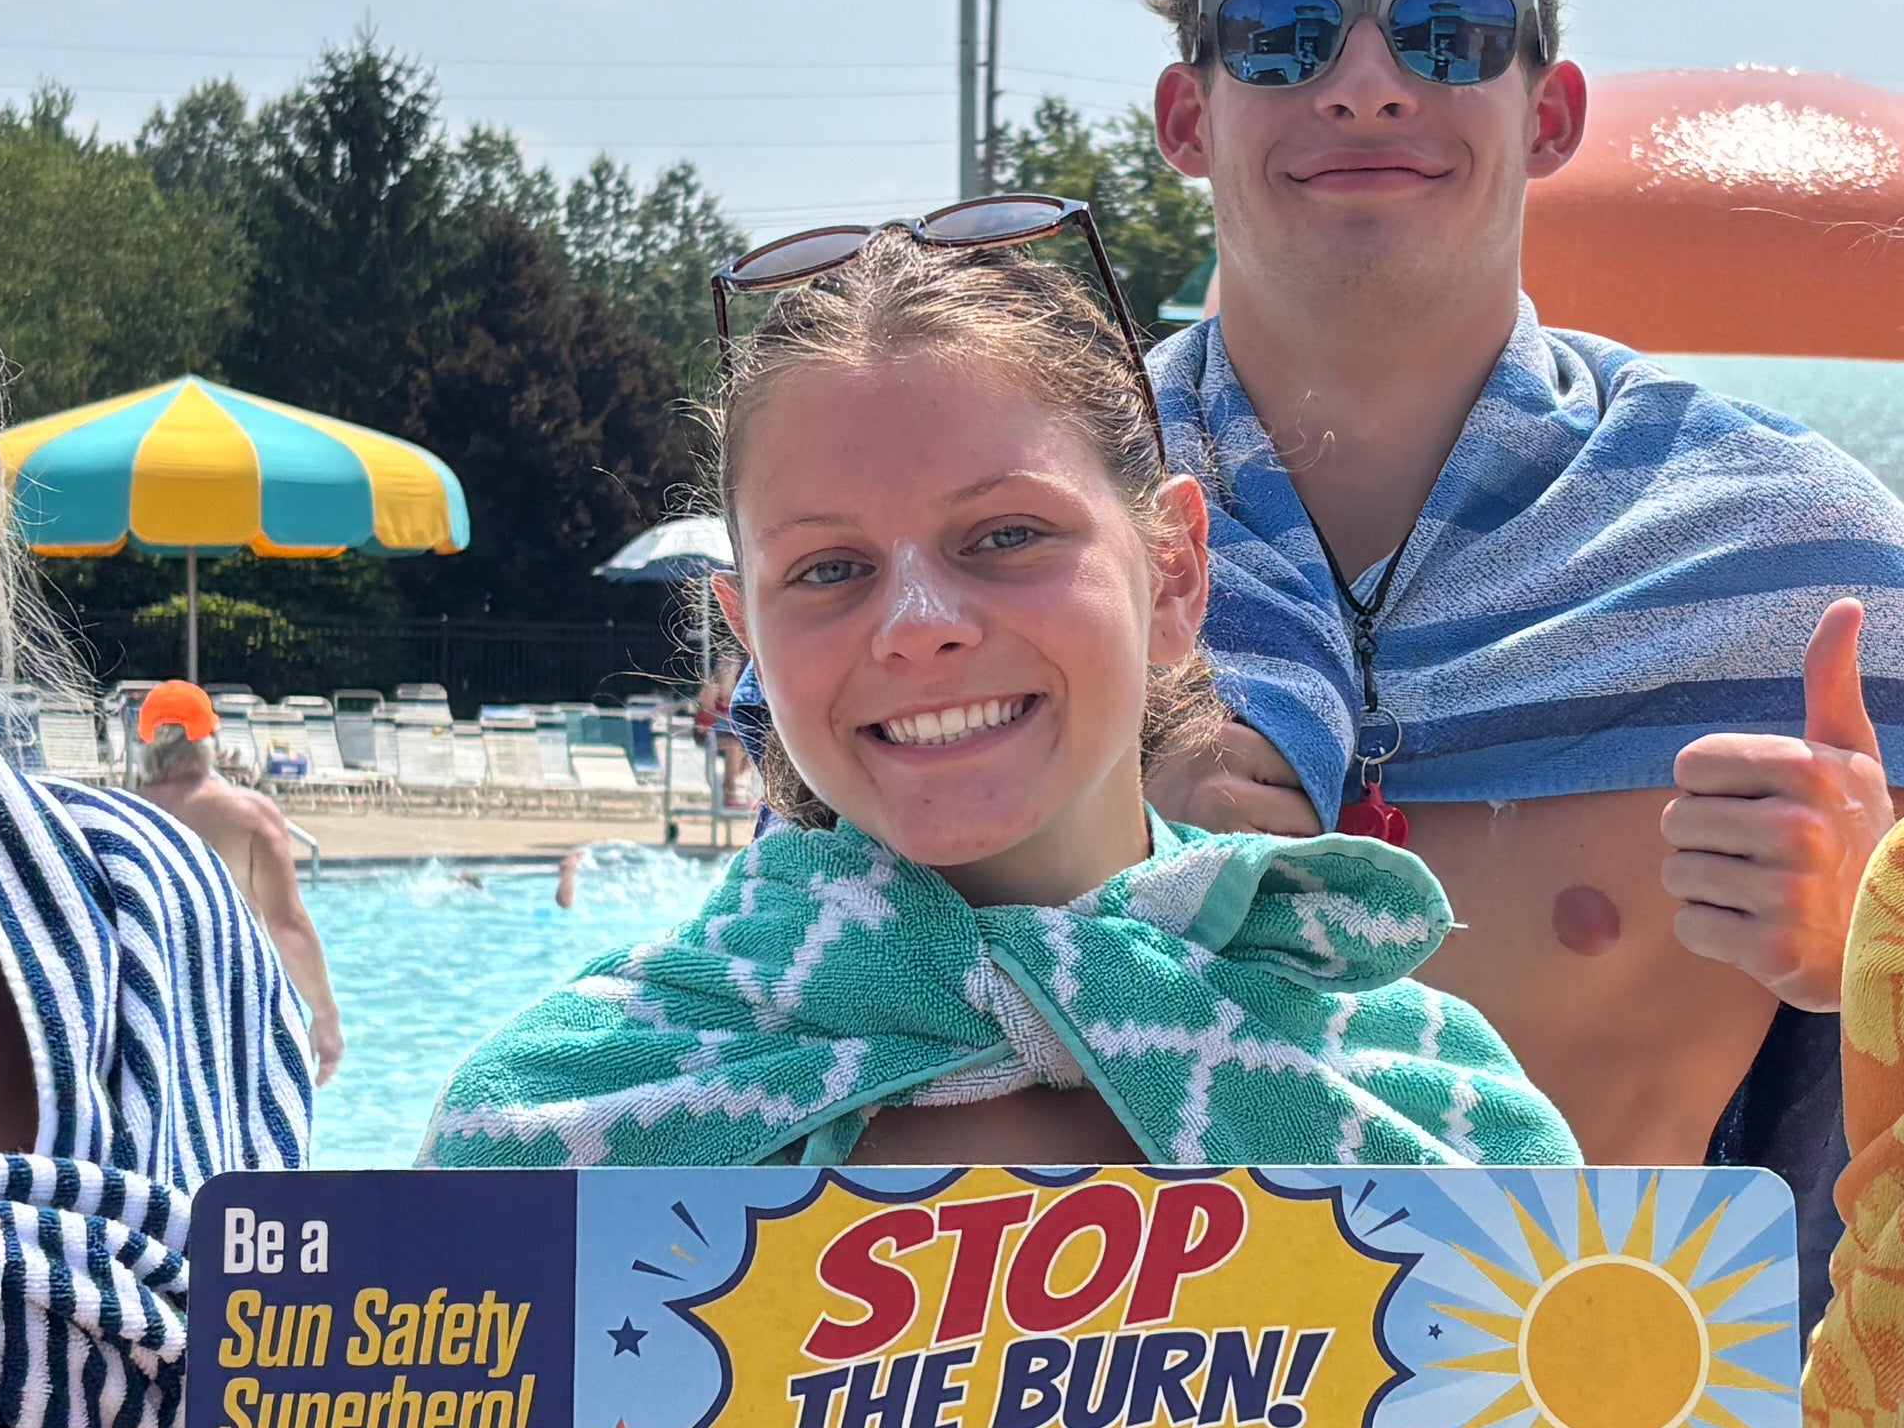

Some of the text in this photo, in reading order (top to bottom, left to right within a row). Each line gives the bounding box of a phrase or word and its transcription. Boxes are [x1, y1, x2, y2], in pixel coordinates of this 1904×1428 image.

[224, 1207, 328, 1273] Be a
[802, 1179, 1247, 1363] STOP
[218, 1288, 531, 1378] Sun Safety
